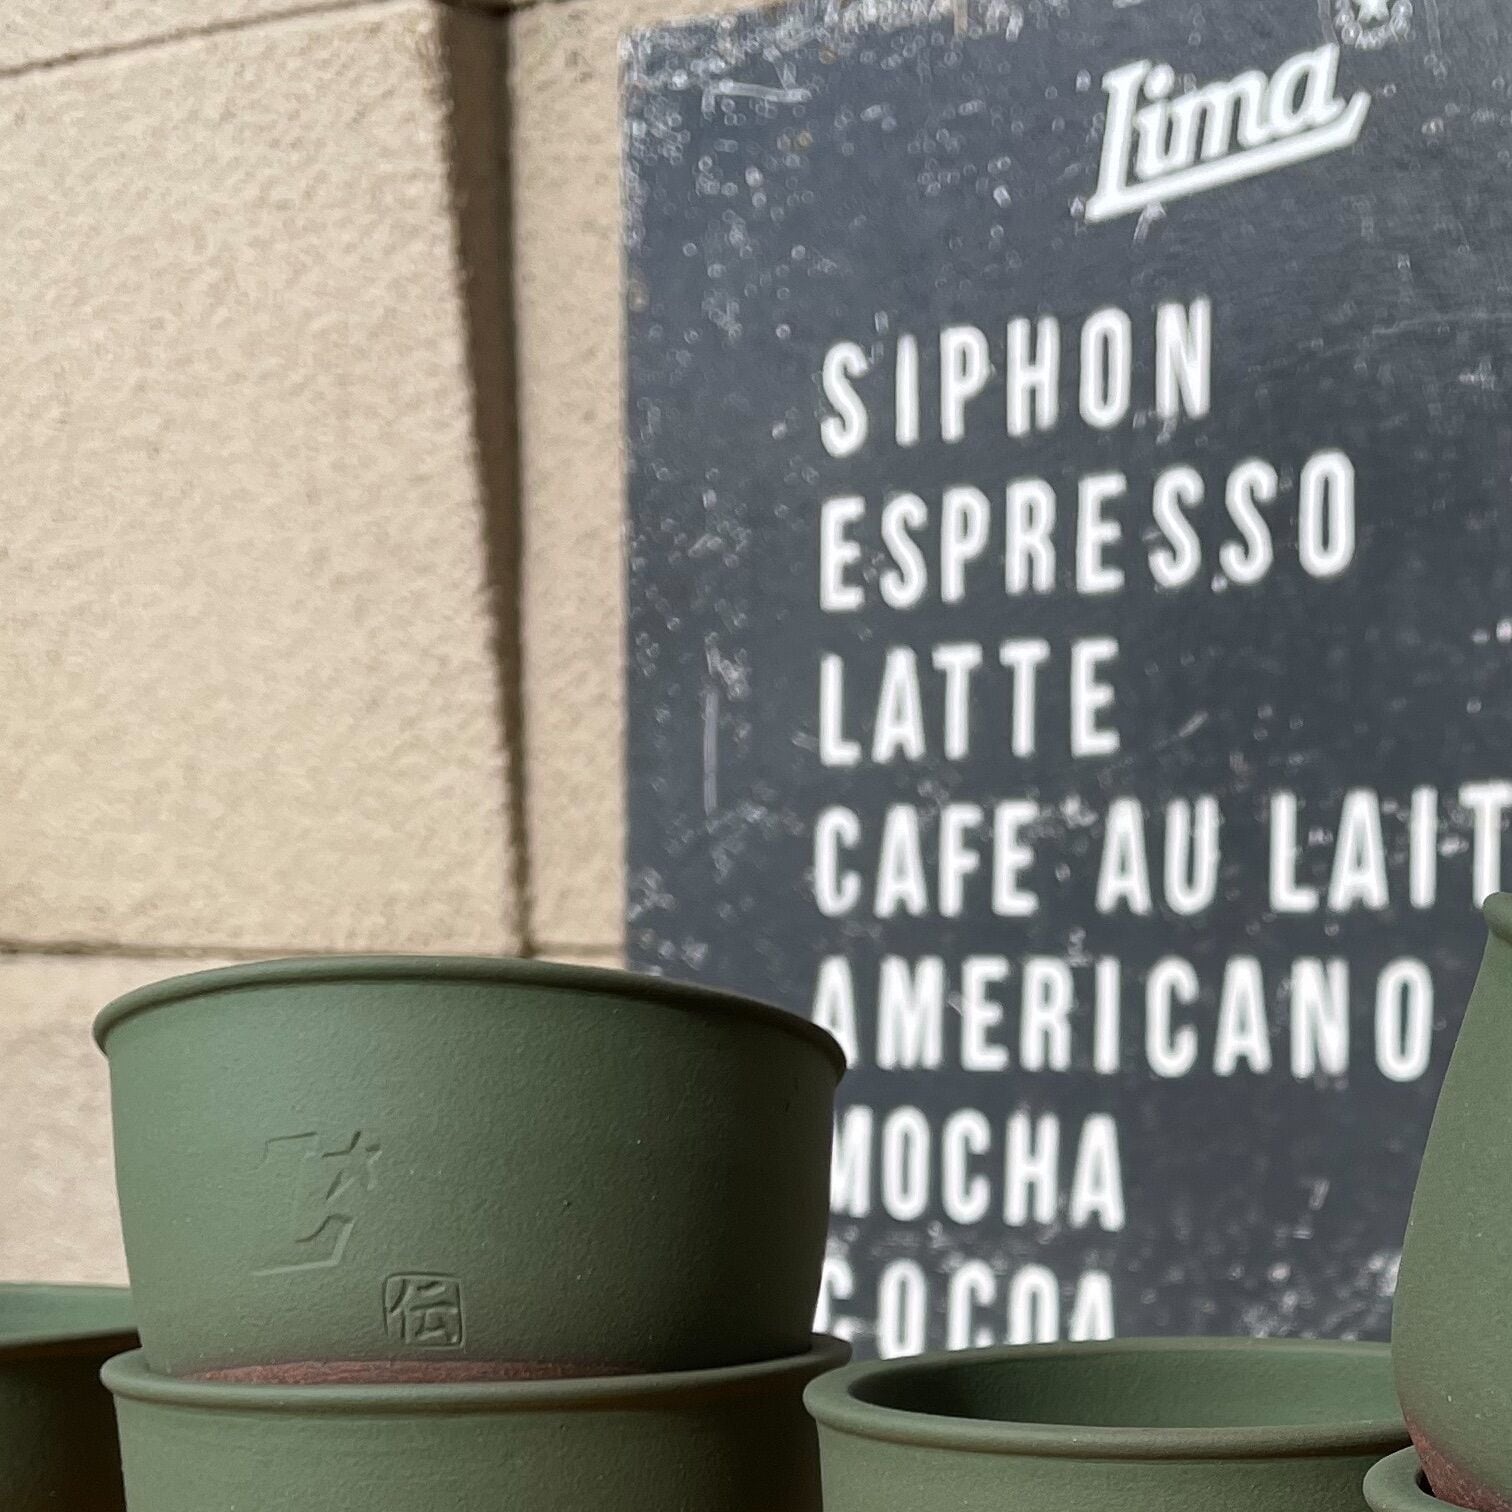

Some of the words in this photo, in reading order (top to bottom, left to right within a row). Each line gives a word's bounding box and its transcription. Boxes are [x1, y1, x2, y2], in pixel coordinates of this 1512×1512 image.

[820, 297, 1211, 458] SIPHON
[820, 450, 1356, 612] ESPRESSO
[818, 638, 1120, 767] LATTE
[812, 800, 1041, 918] CAFE
[1096, 796, 1220, 915] AU
[810, 955, 1434, 1082] AMERICANO
